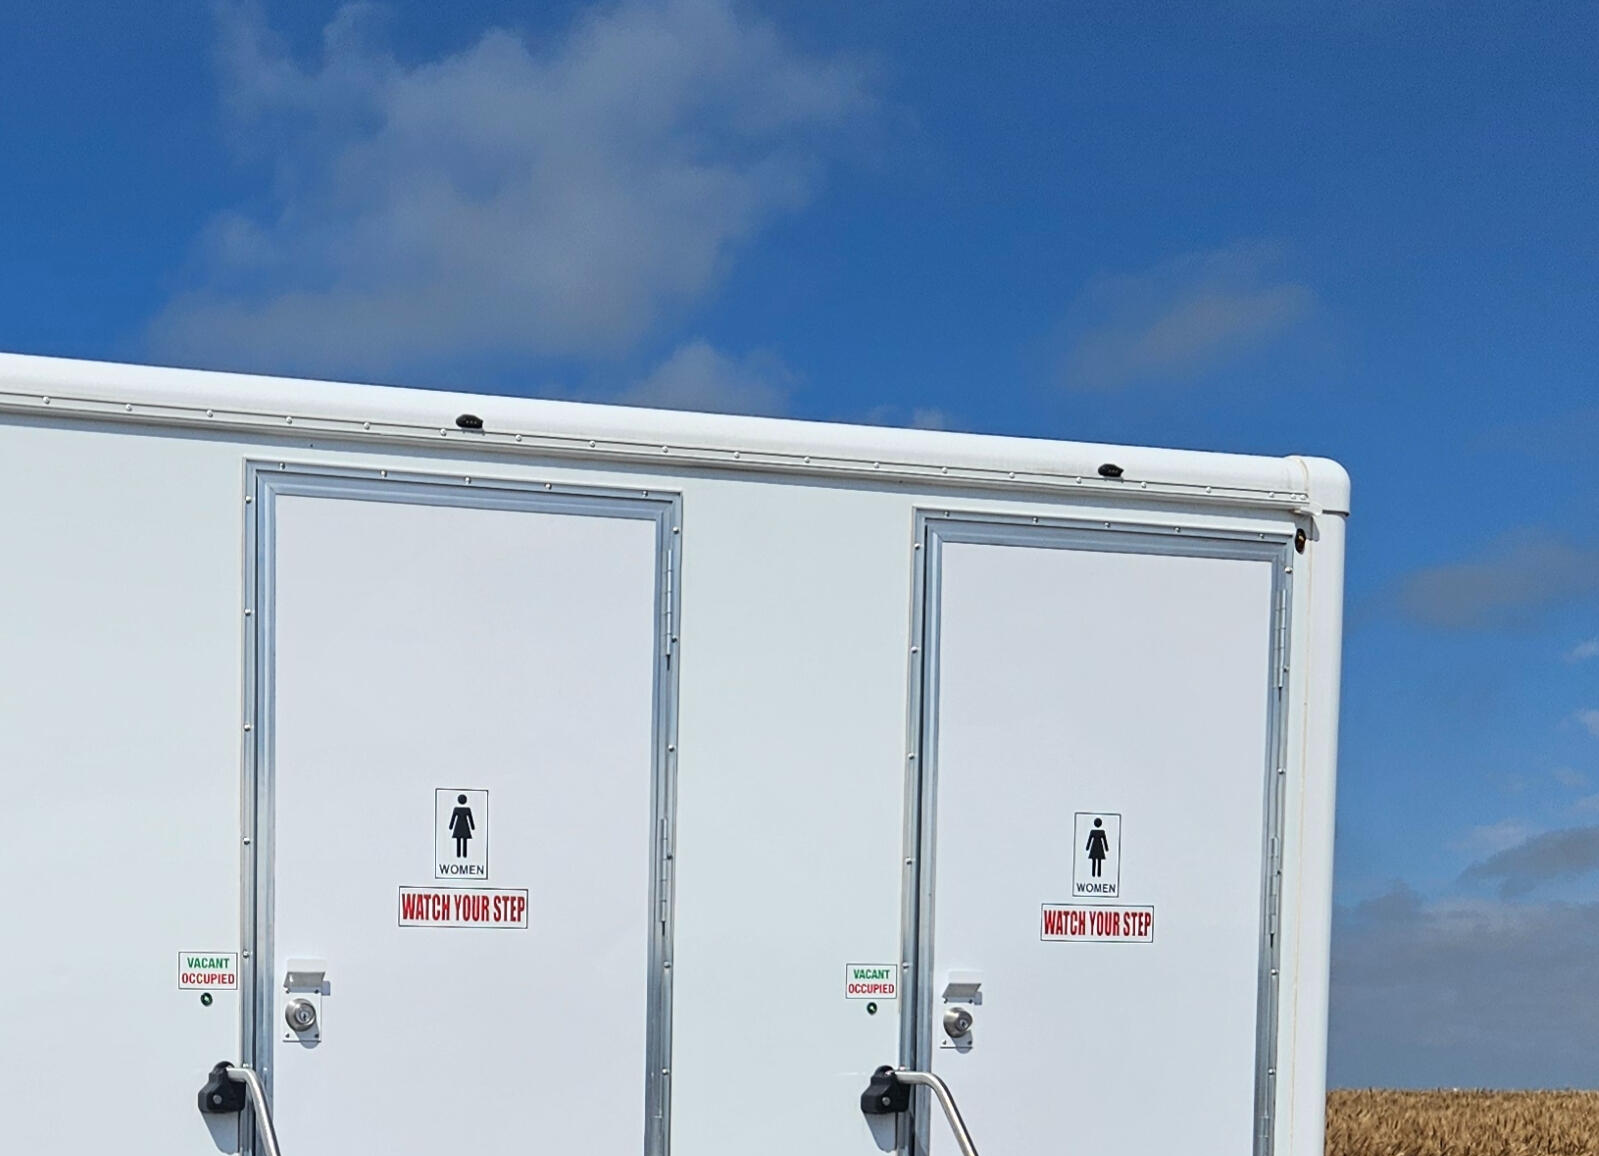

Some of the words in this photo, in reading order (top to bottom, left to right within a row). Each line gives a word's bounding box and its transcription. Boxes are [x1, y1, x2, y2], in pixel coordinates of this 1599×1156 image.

[439, 864, 484, 875] WOMEN
[1076, 882, 1116, 894] WOMEN
[402, 893, 451, 921] WATCH
[454, 895, 490, 922] YOUR
[493, 895, 526, 922] STEP
[1043, 910, 1087, 936] WATCH
[1089, 911, 1121, 937] YOUR
[1123, 911, 1152, 937] STEP
[187, 957, 230, 969] VACANT
[181, 973, 235, 985] OCCUPIED
[853, 968, 891, 980] VACANT
[848, 983, 895, 994] OCCUPIED
